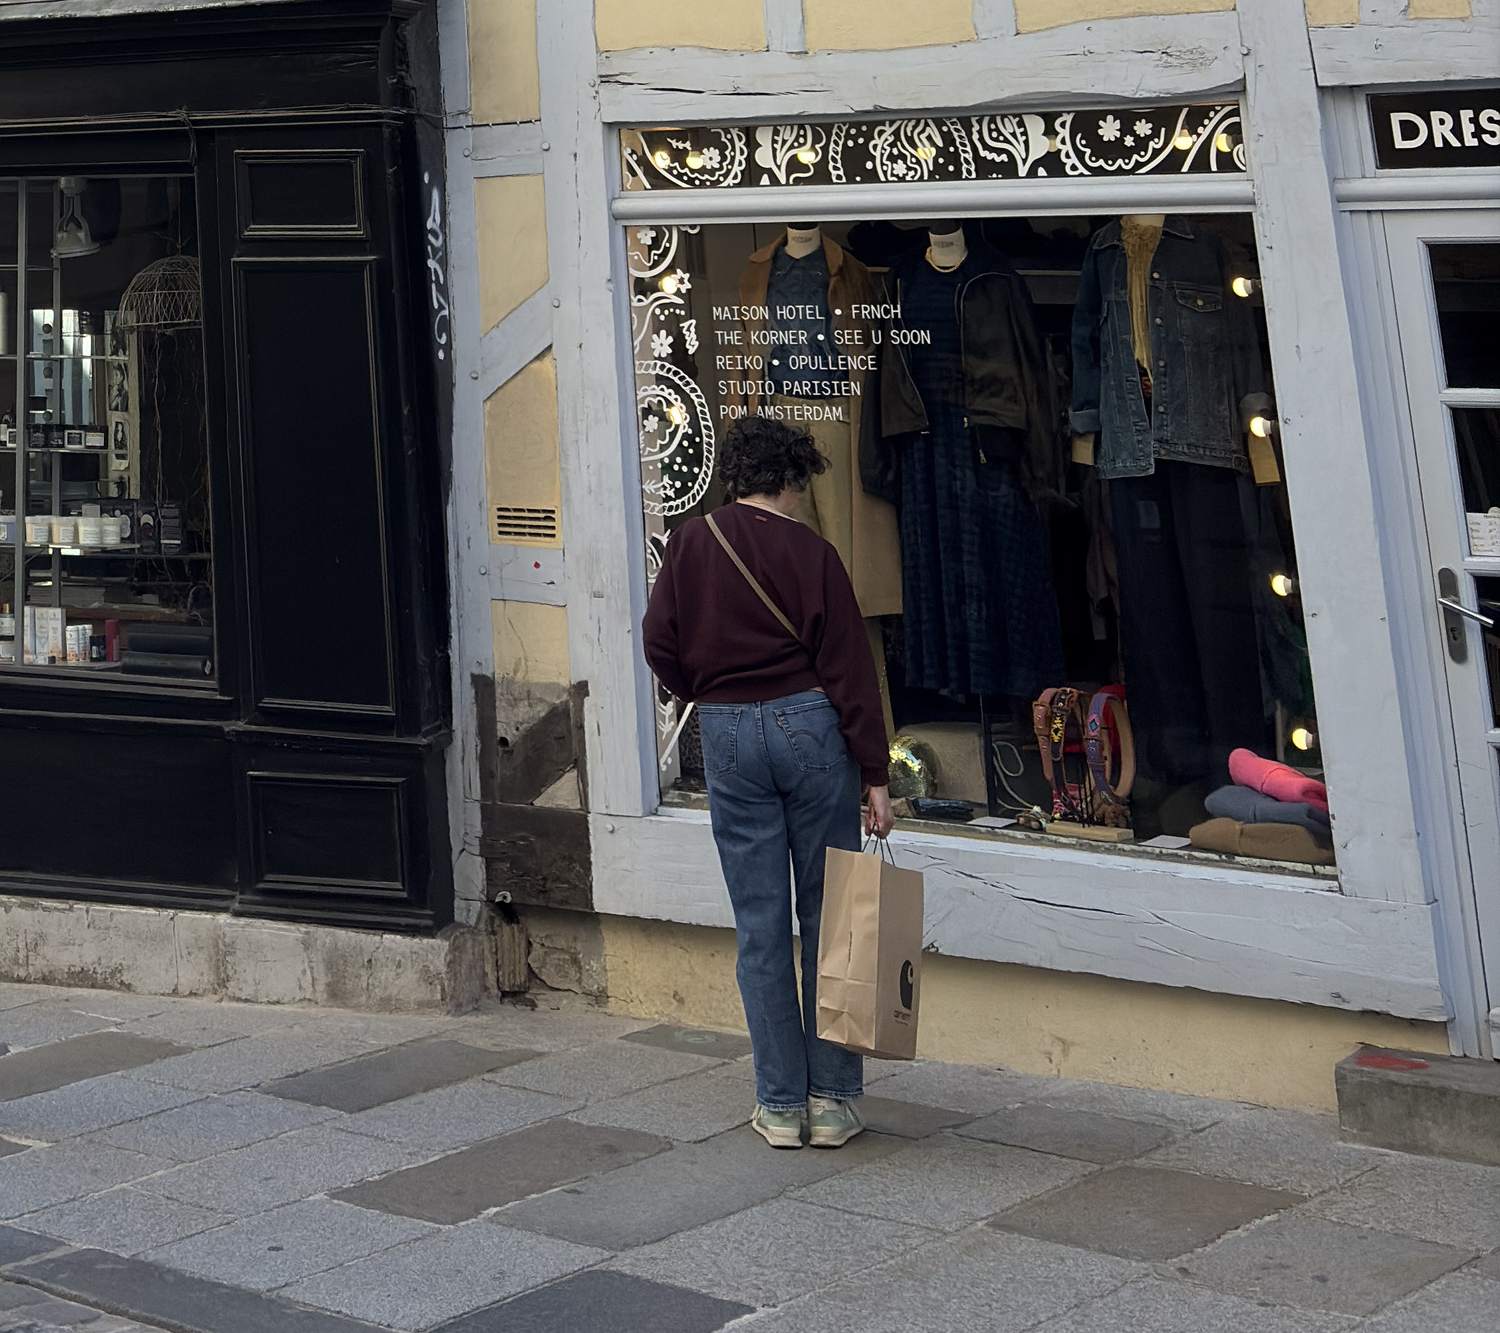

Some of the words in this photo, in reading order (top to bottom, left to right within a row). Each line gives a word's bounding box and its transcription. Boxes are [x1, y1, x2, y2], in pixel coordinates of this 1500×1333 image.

[1389, 108, 1500, 149] DRES
[712, 305, 769, 320] MAISON
[776, 305, 825, 320] HOTEL
[851, 304, 901, 319] FRNCH
[714, 330, 743, 345] THE
[751, 330, 808, 345] KORNER
[834, 330, 864, 345] SEE
[872, 330, 882, 344] U
[890, 329, 931, 344] SOON
[716, 355, 763, 370] REIKO
[789, 355, 878, 370] OPULLENCE
[718, 381, 775, 395] STUDIO
[783, 381, 861, 396] PARISIEN
[720, 405, 747, 420] POM
[756, 406, 843, 421] AMSTERDAM
